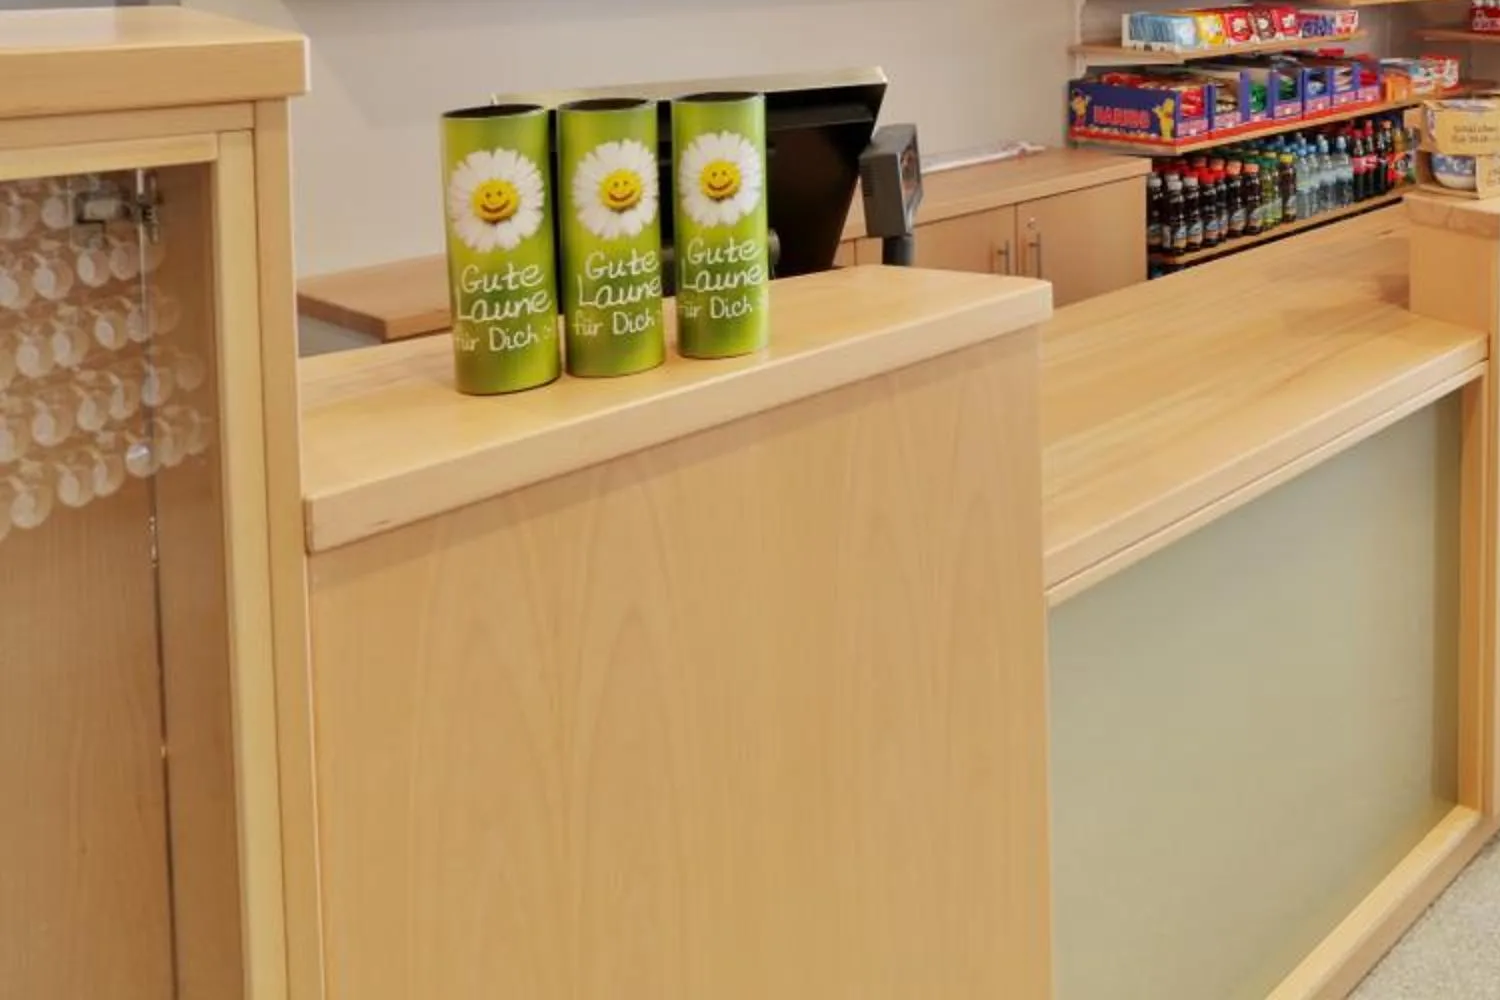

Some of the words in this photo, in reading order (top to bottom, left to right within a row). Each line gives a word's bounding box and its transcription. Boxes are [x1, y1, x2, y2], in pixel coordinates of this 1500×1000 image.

[584, 248, 660, 281] Gute
[687, 237, 763, 266] Gute
[462, 261, 544, 294] Gute
[576, 275, 662, 309] Laune
[681, 258, 766, 293] Laune
[455, 286, 552, 323] Laune
[709, 294, 754, 319] Dich
[489, 323, 539, 351] Dich
[572, 309, 603, 337] für
[612, 308, 656, 335] Dich
